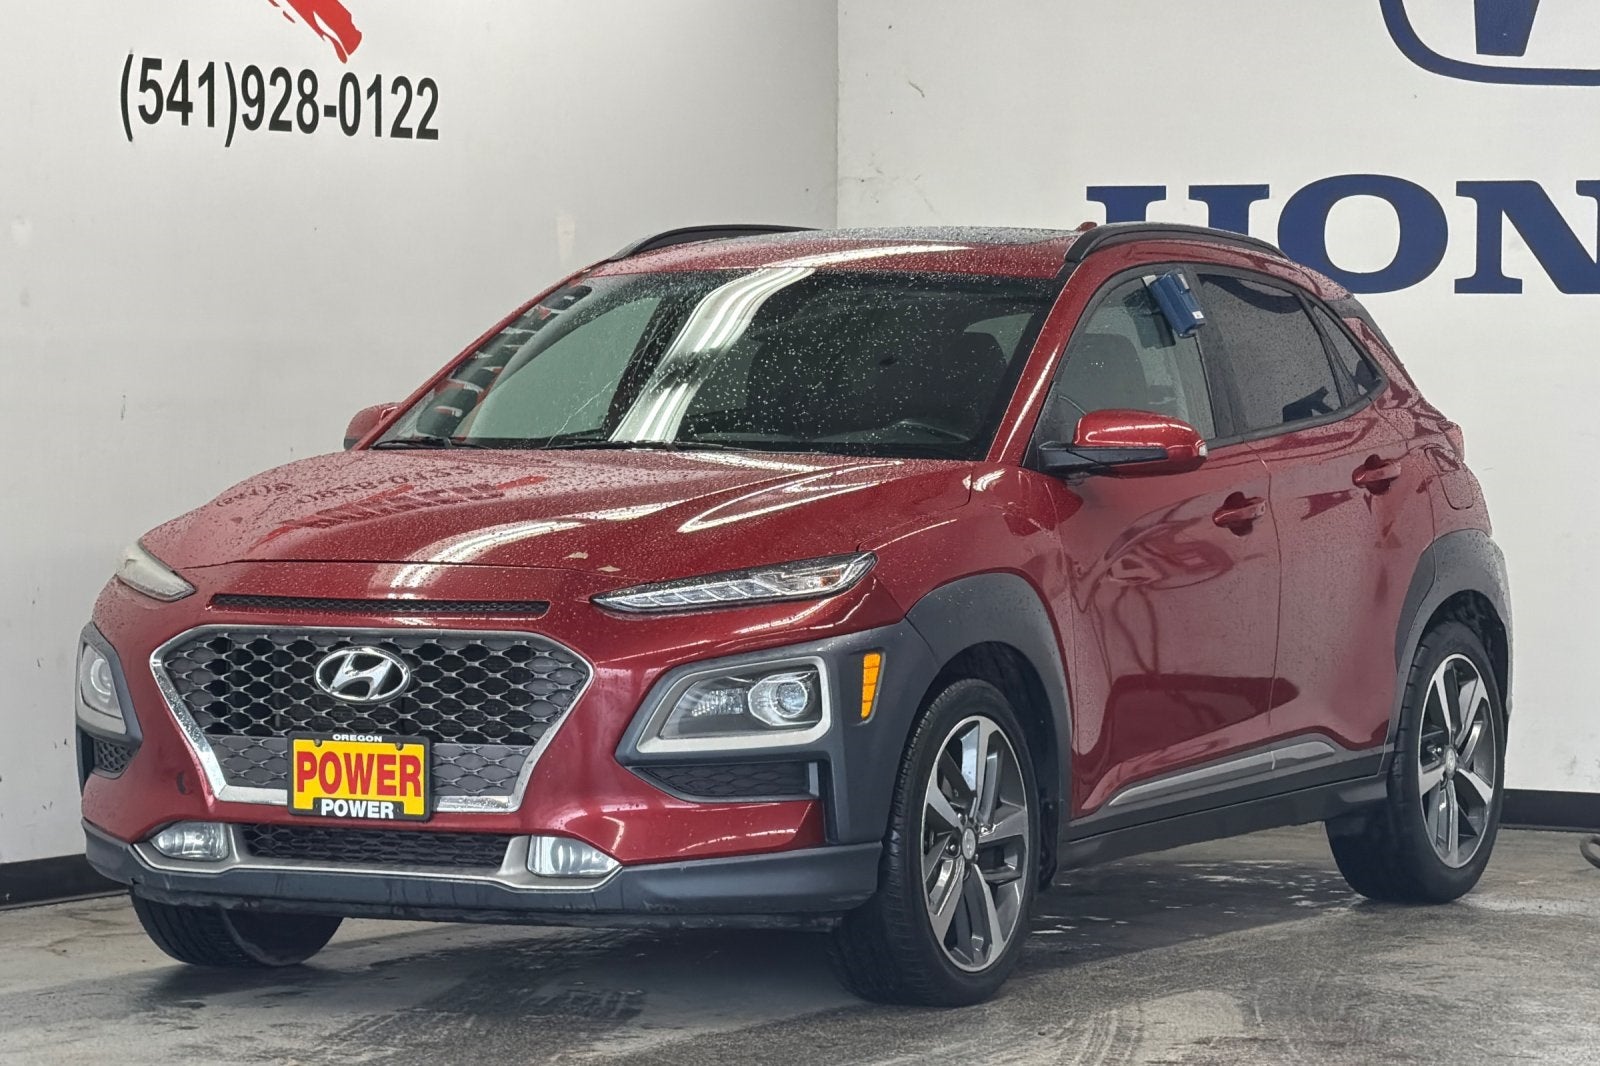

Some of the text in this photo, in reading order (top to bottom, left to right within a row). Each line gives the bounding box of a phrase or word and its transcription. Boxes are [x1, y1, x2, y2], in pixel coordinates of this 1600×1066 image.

[120, 53, 439, 148] (541)928-0122
[332, 733, 383, 743] OREGON
[296, 750, 422, 798] POWER
[320, 798, 394, 819] POWER
